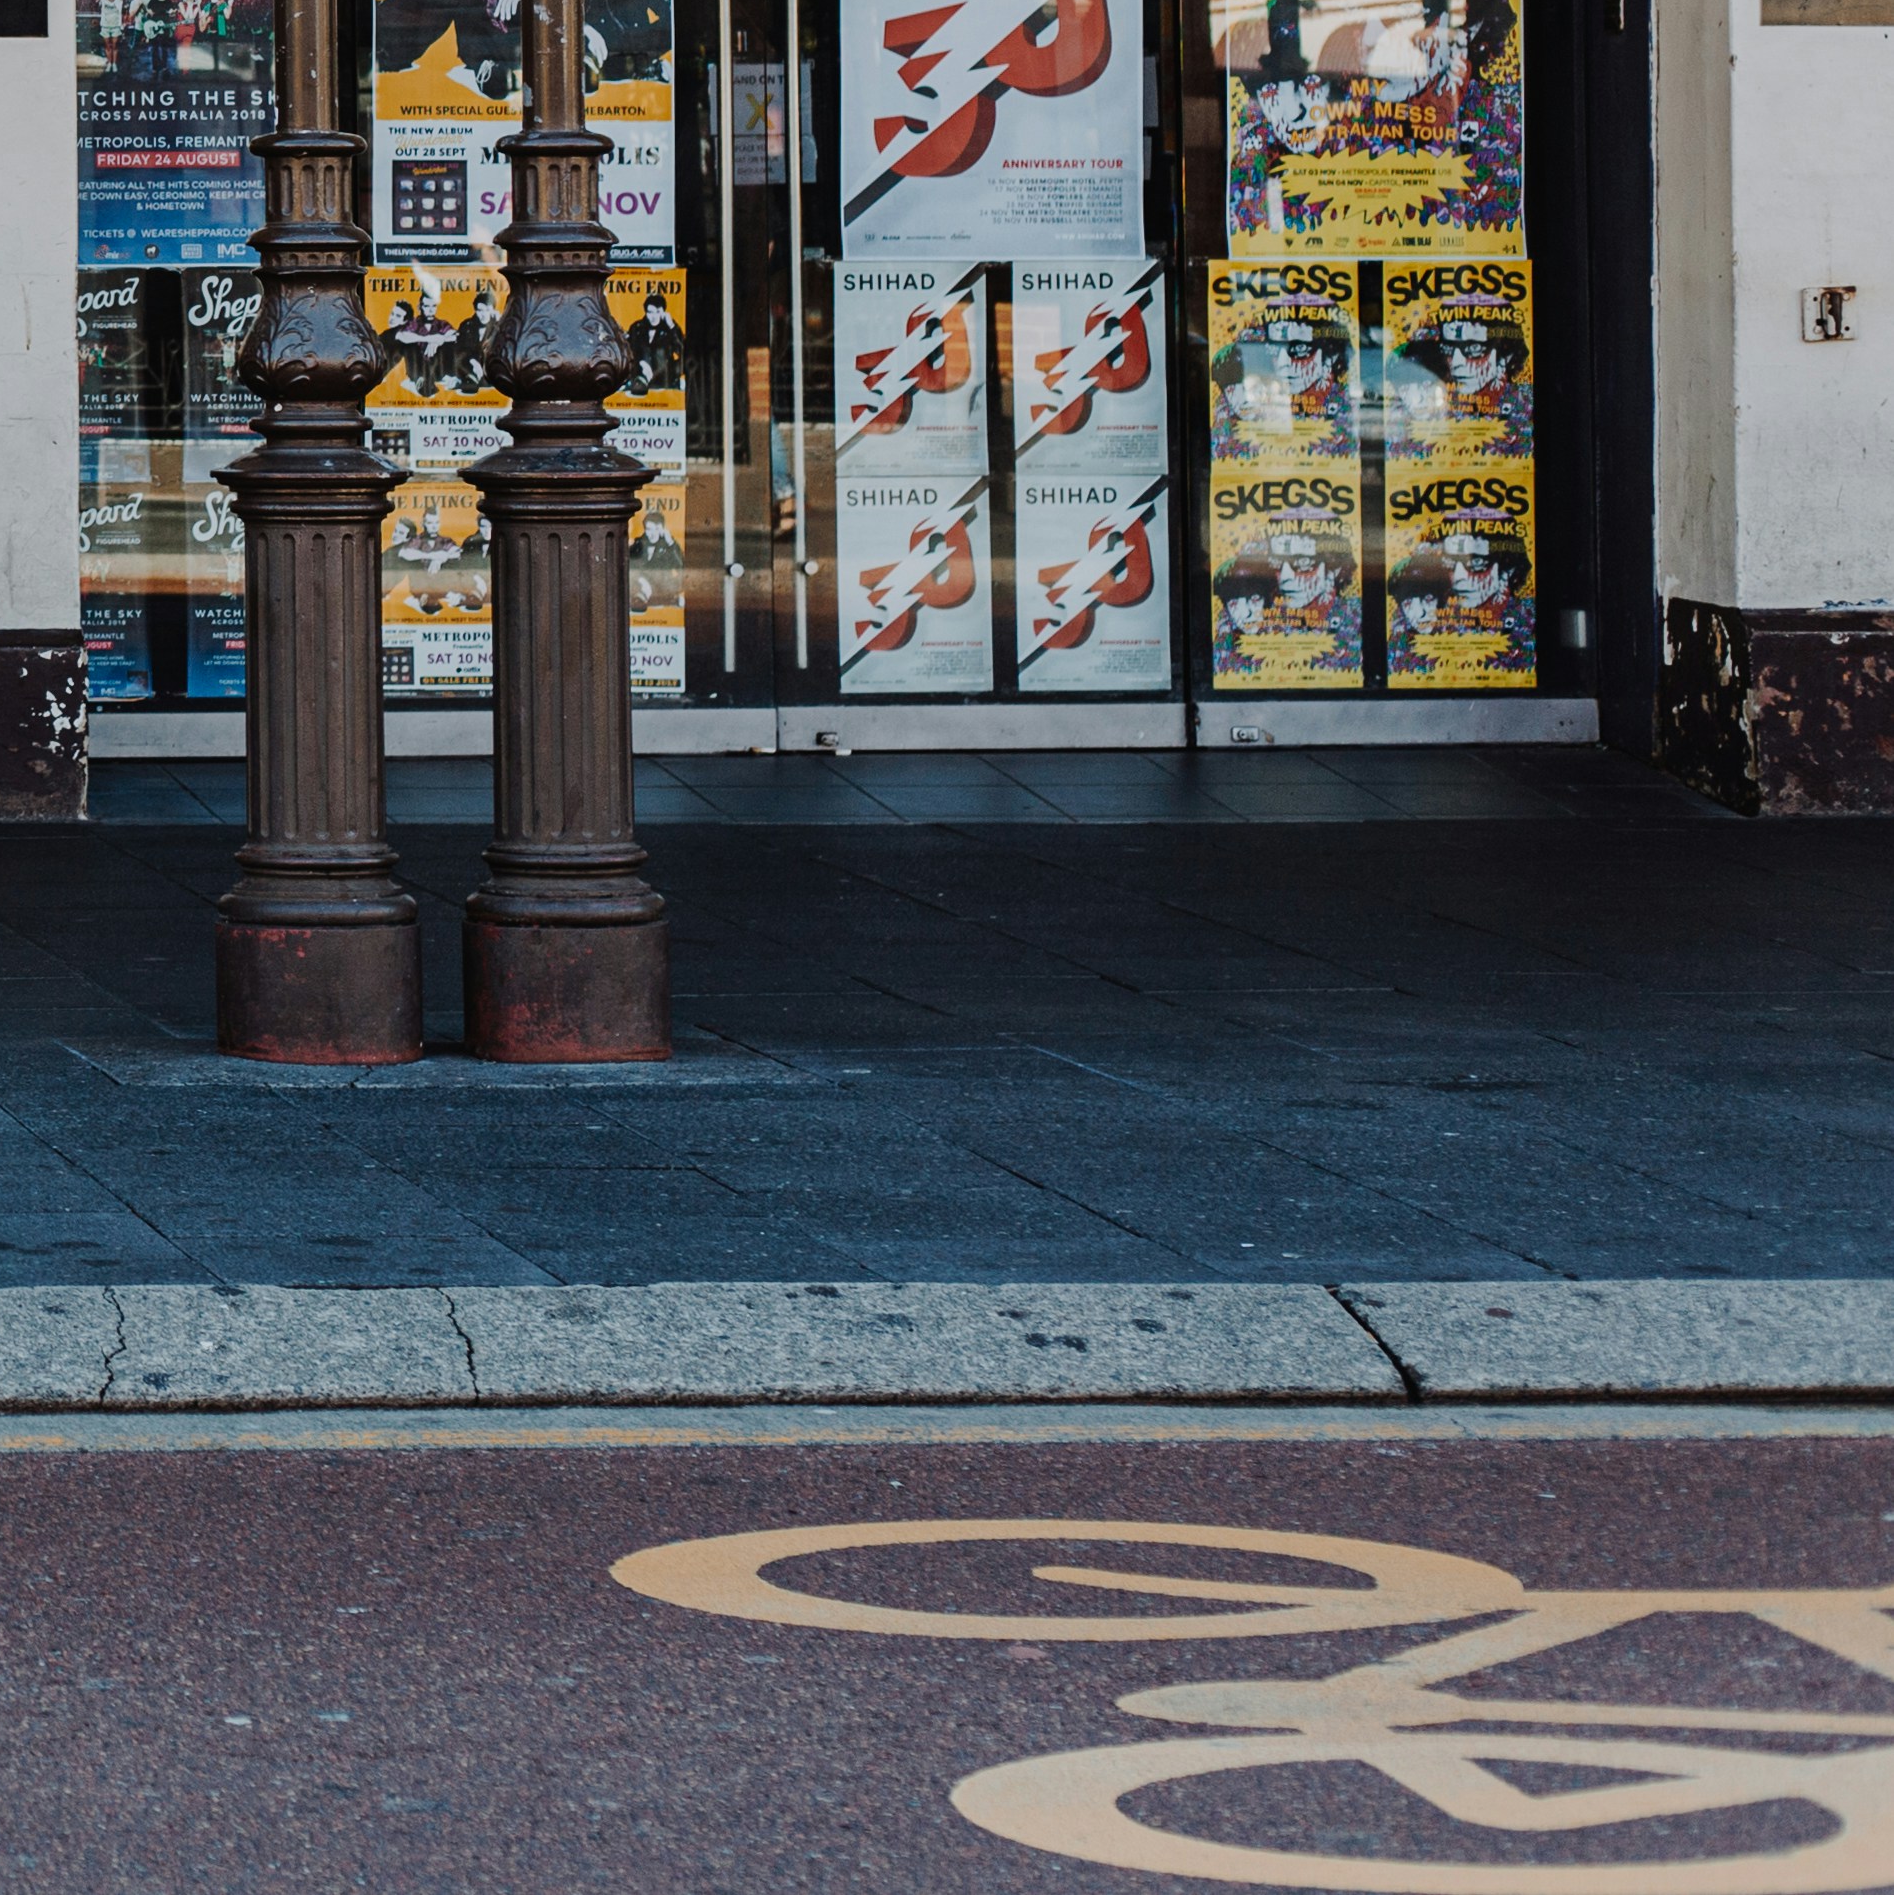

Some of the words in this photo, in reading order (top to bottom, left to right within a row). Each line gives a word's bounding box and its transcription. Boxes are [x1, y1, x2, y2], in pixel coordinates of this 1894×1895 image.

[1351, 79, 1388, 97] MY
[188, 90, 236, 105] THE
[139, 110, 224, 120] AUSTRALIA
[231, 110, 266, 119] 2018
[400, 106, 432, 116] WITH
[436, 106, 483, 116] SPECIAL
[1310, 103, 1361, 124] OWN
[1374, 102, 1437, 123] MESS
[1290, 123, 1403, 145] AUSTRALIAN
[1411, 125, 1457, 142] TOUR
[395, 148, 419, 157] OUT
[423, 148, 435, 156] 28
[439, 148, 466, 156] SEPT
[97, 154, 150, 166] FRIDAY
[155, 154, 171, 165] 24
[176, 153, 237, 166] AUGUST
[1002, 159, 1085, 169] ANNIVERSARY
[1091, 159, 1123, 169] TOUR
[145, 202, 204, 210] HOMETOWN
[83, 229, 124, 238] TICKETS
[384, 248, 469, 256] THELIVINGEND.COM.AU
[1212, 264, 1353, 307] SKEGSS
